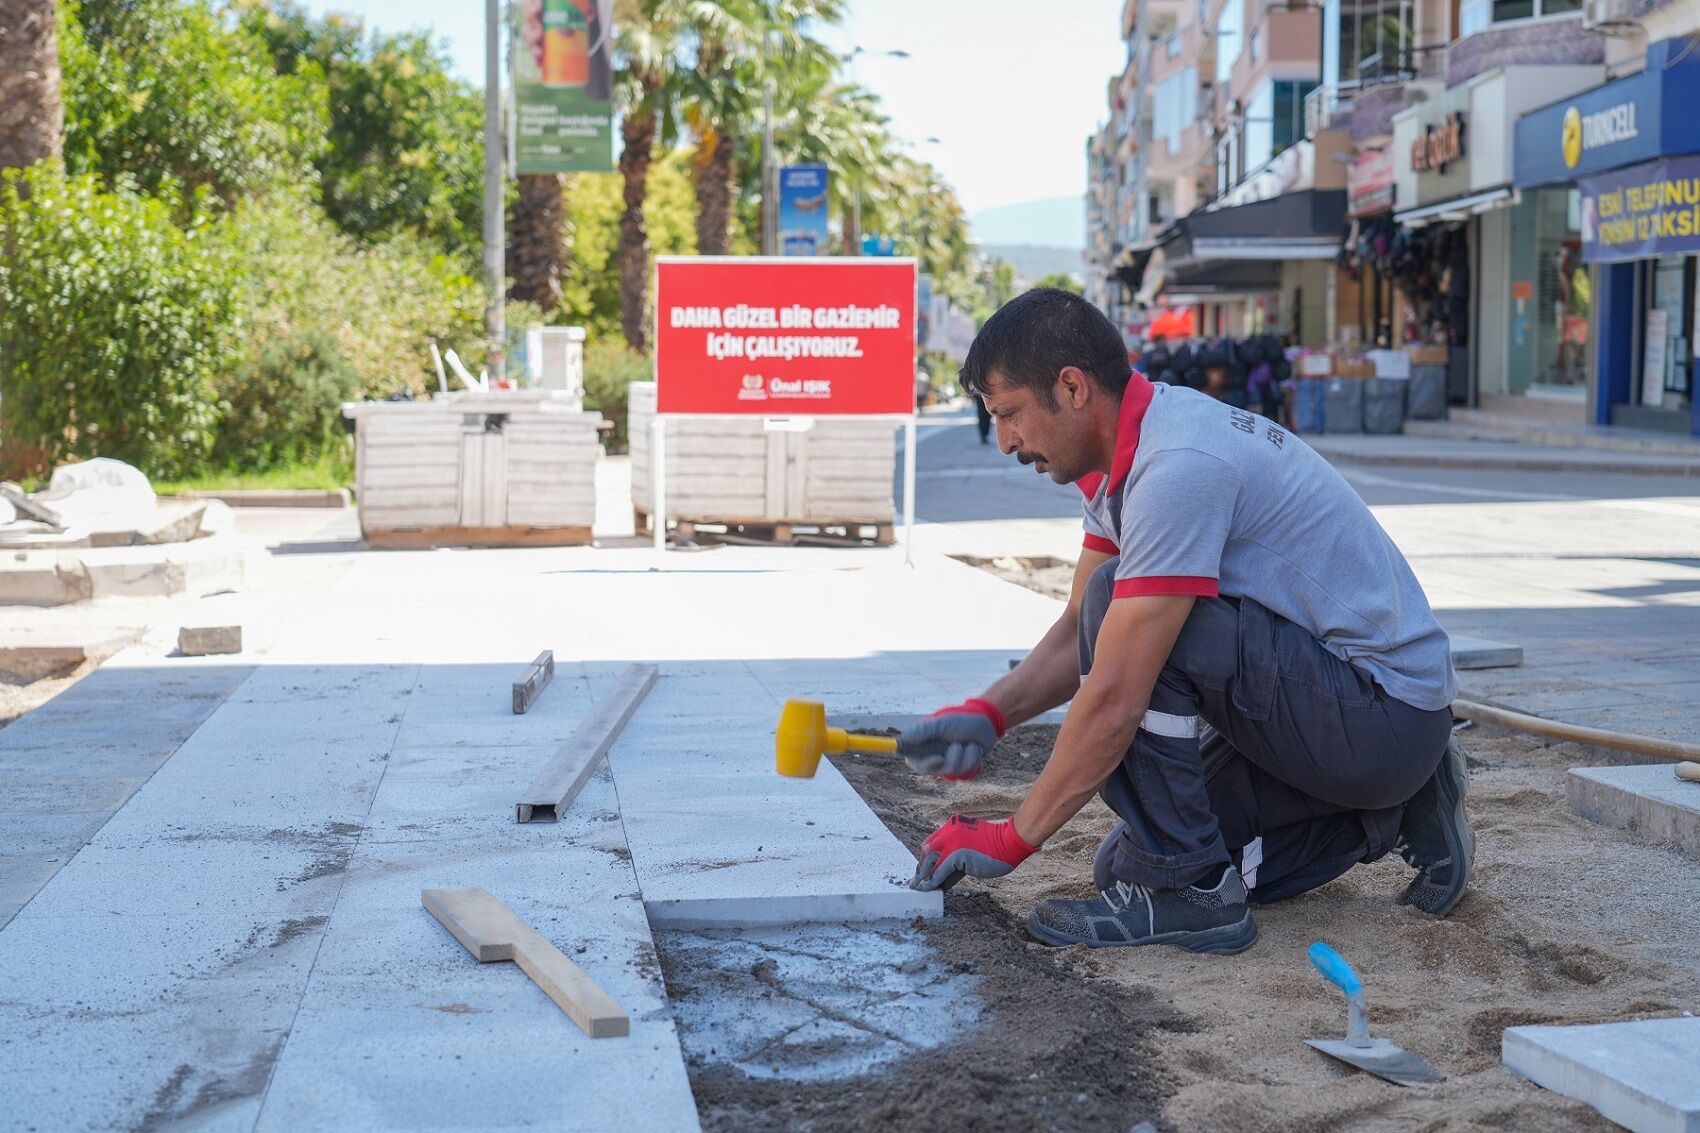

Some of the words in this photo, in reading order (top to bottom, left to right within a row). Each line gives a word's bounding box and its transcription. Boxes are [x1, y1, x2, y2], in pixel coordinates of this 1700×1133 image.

[671, 306, 721, 328] DAHA
[723, 304, 779, 328] GÜZEL
[780, 304, 812, 328] BİR
[813, 304, 900, 328] GAZİEMİR
[706, 332, 743, 360] İÇİN
[745, 335, 863, 361] ÇALIŞIYORUZ.
